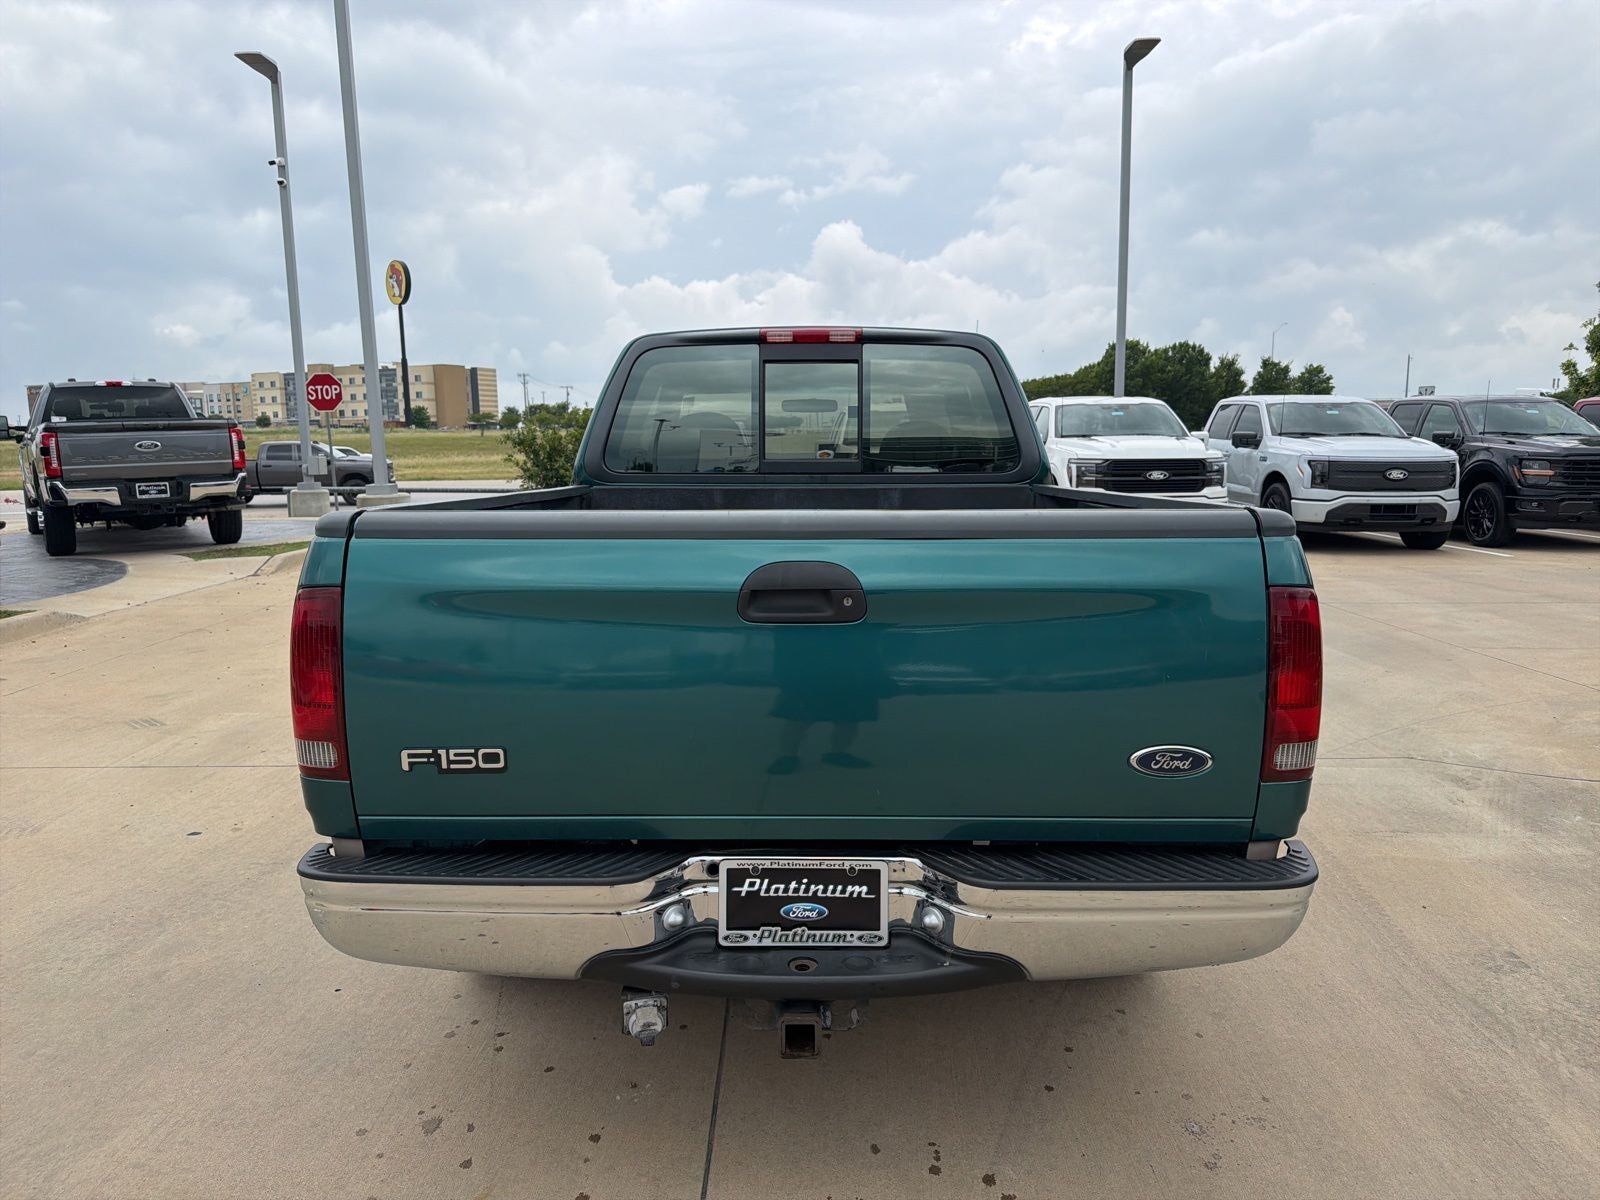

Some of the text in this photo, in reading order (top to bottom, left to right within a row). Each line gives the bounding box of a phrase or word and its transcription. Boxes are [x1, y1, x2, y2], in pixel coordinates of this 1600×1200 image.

[308, 385, 340, 400] STOP
[1150, 752, 1193, 769] Ford
[731, 878, 876, 898] Platinum
[789, 905, 819, 918] Ford
[757, 928, 854, 944] Platinum
